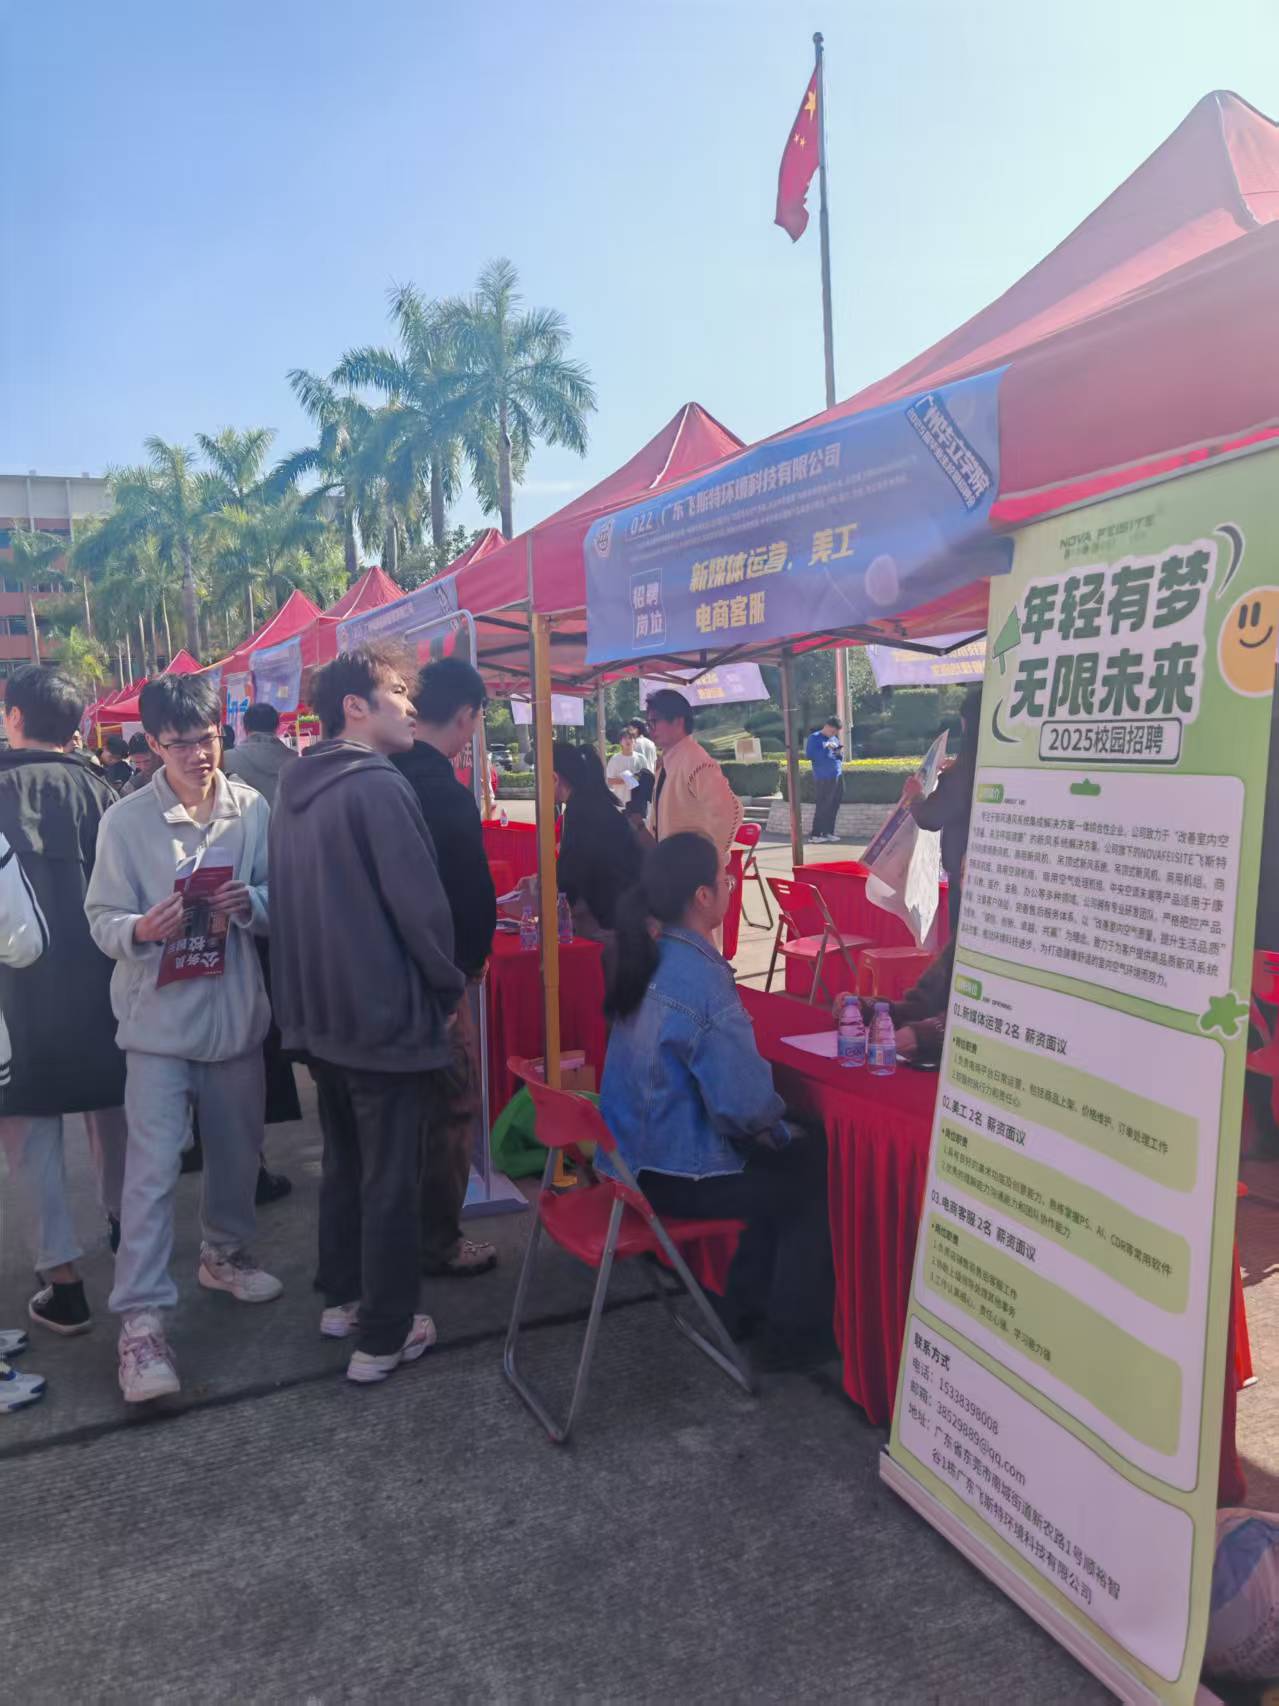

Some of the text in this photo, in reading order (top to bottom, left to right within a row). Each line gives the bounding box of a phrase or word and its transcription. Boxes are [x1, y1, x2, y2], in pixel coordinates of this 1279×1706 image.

[696, 591, 765, 633] 电商客服
[1021, 550, 1211, 645] 年轻有梦
[1009, 642, 1199, 719] 无限未来
[1048, 725, 1164, 754] 2025校园招聘
[1005, 1022, 1020, 1040] 2名
[1025, 1028, 1068, 1055] 薪资面议
[969, 1109, 982, 1127] 2名
[987, 1115, 1026, 1147] 薪资面议
[977, 1217, 992, 1237] 2名
[996, 1227, 1036, 1262] 薪资面议
[914, 1332, 951, 1371] 联系方式
